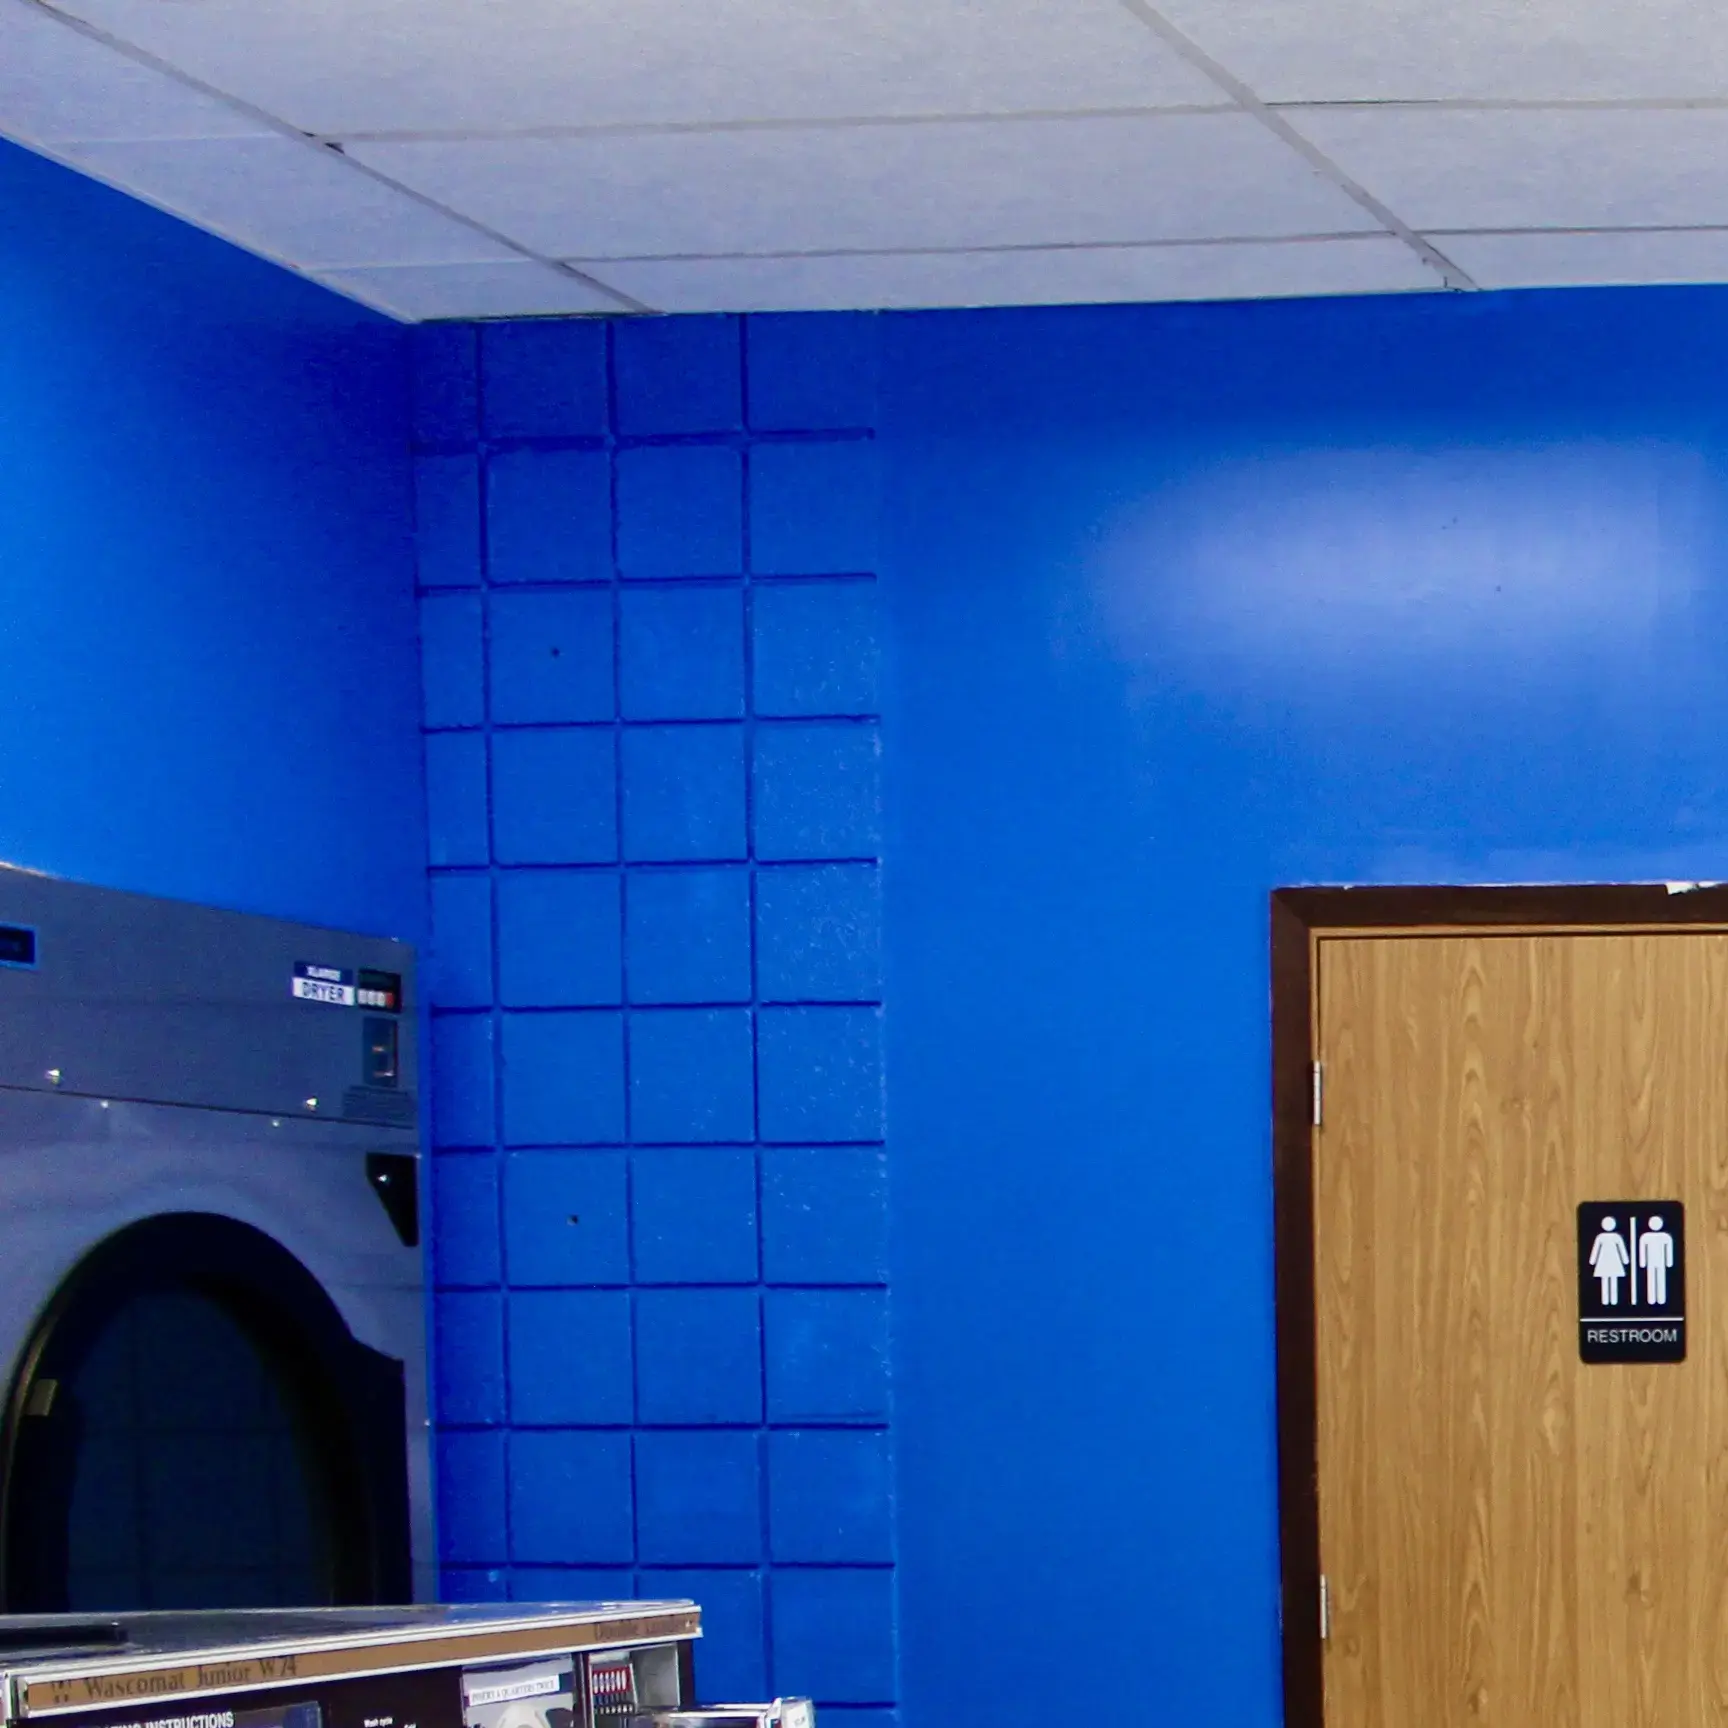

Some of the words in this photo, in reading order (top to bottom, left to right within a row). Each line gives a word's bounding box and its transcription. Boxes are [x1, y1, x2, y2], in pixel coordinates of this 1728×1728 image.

[302, 981, 344, 1001] DRYER
[1587, 1328, 1677, 1343] RESTROOM
[84, 1671, 185, 1699] Wascomat
[197, 1662, 250, 1688] Junior
